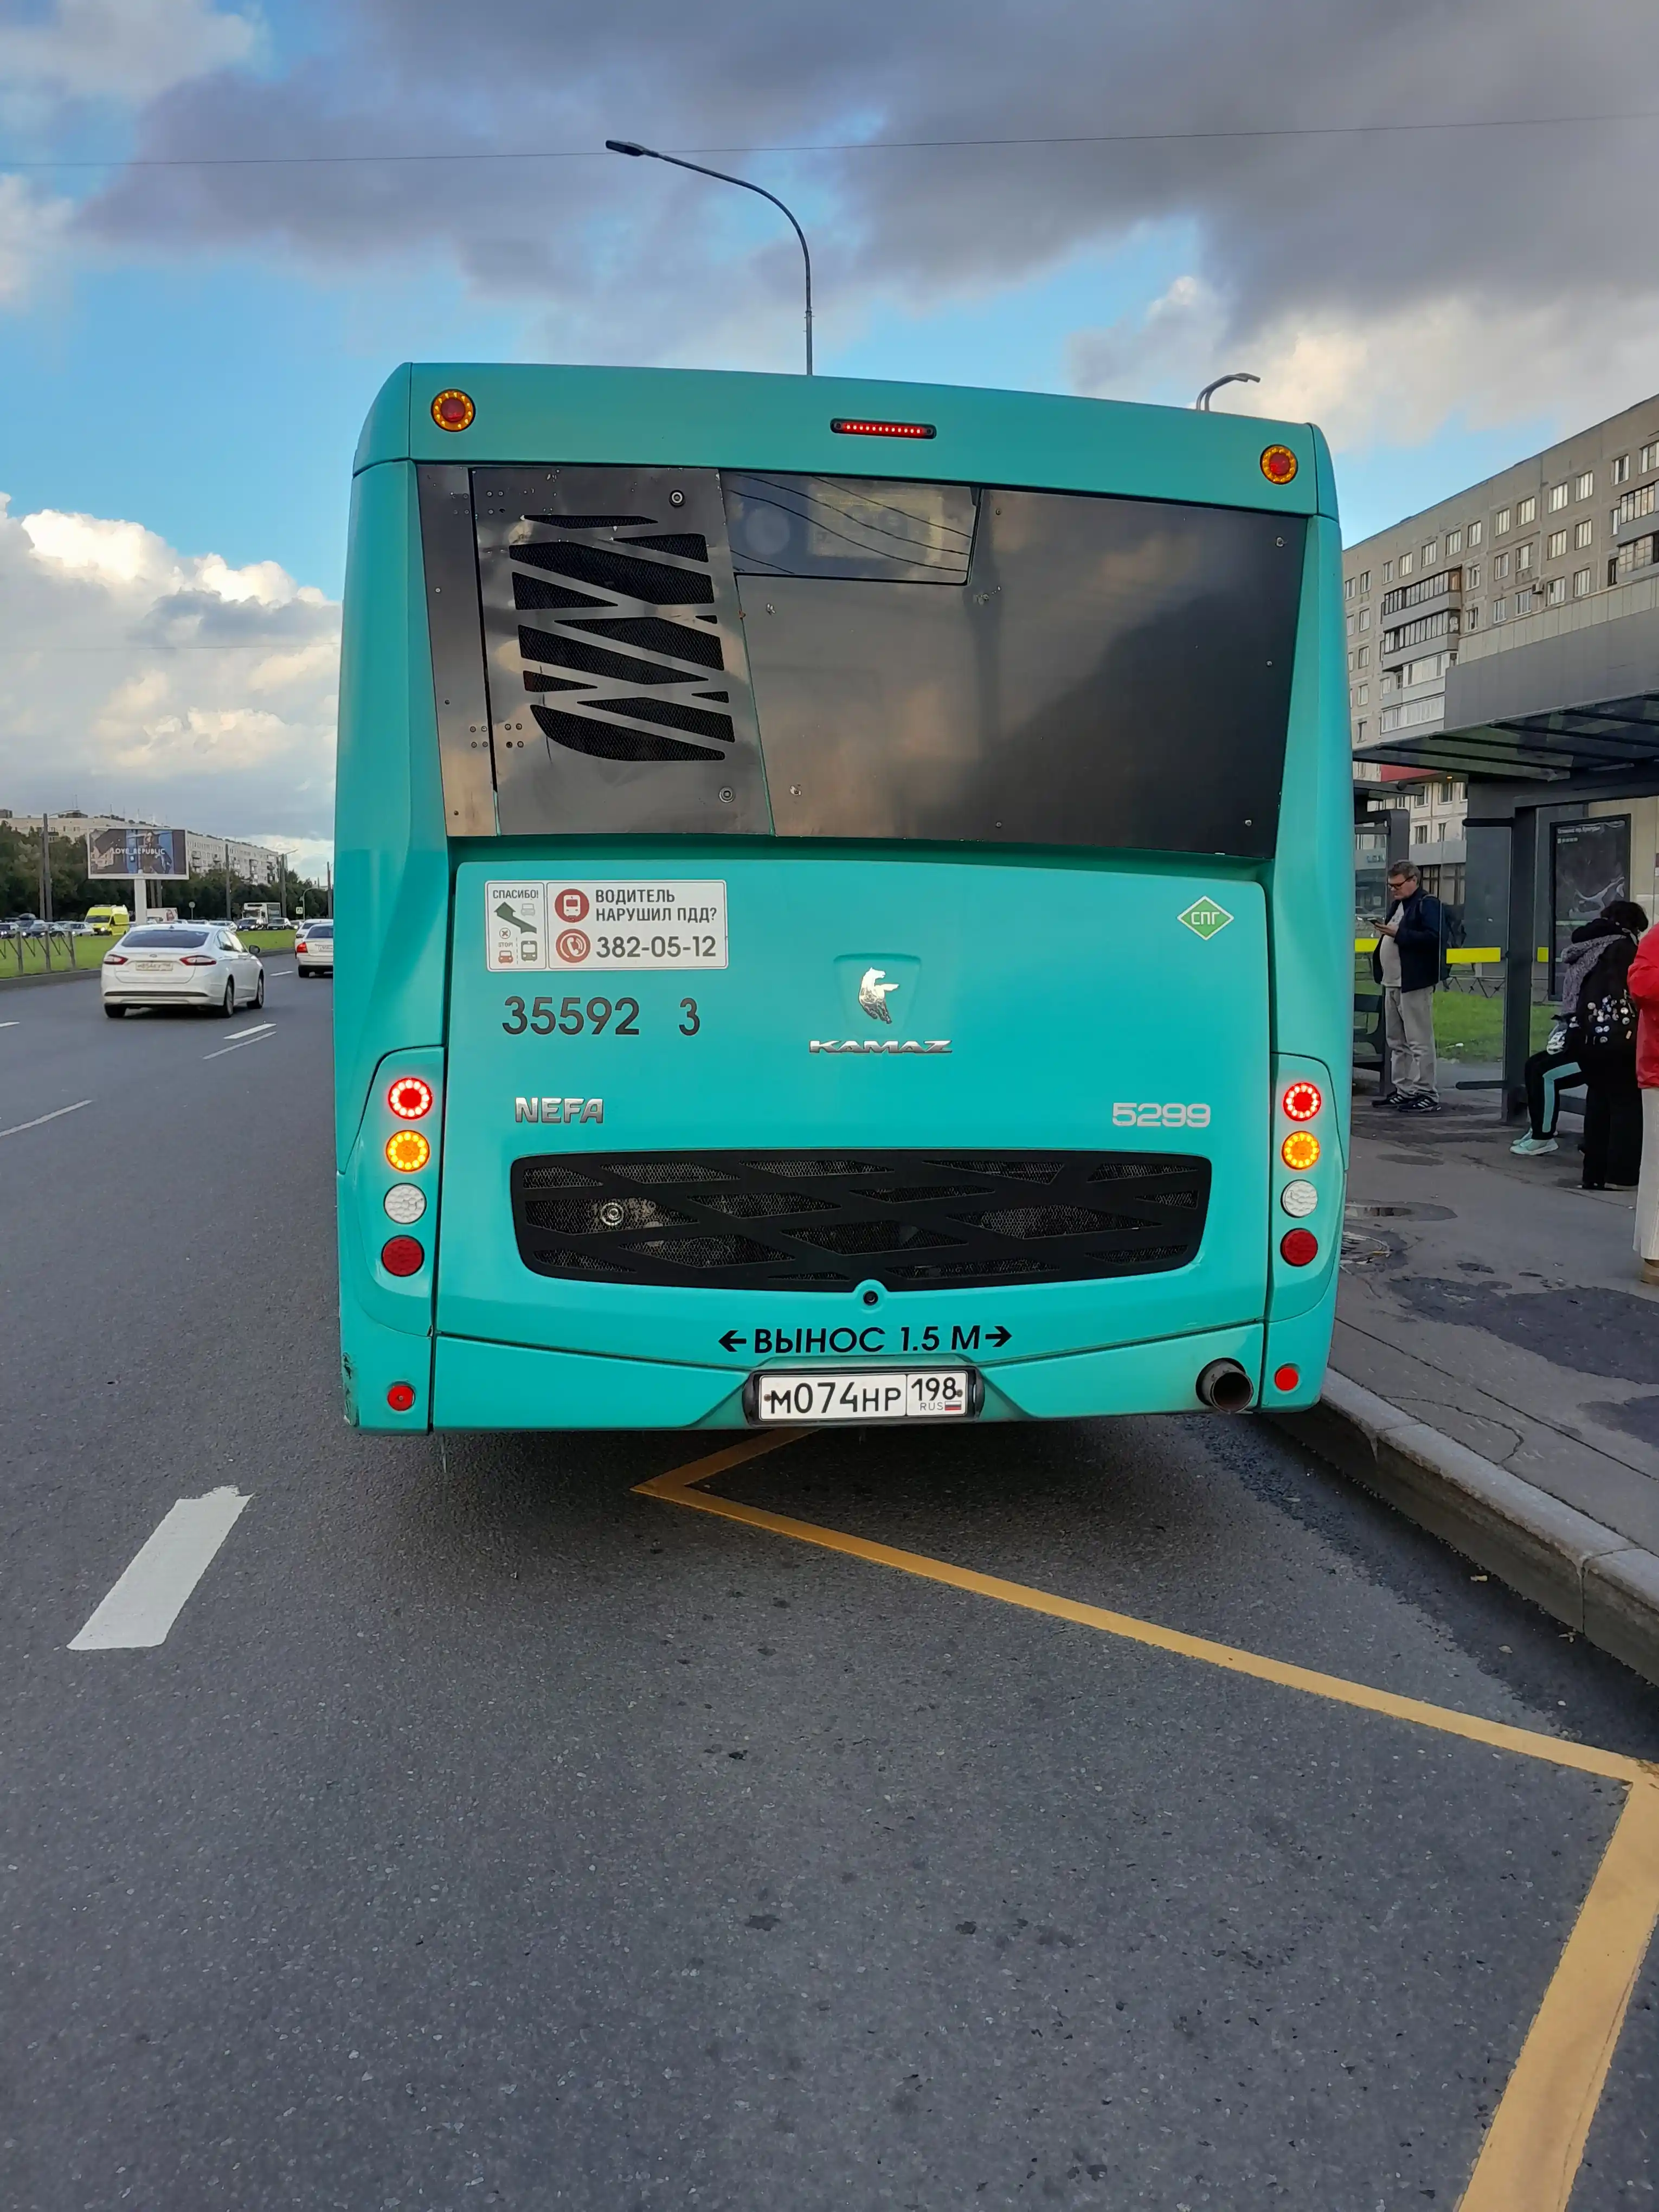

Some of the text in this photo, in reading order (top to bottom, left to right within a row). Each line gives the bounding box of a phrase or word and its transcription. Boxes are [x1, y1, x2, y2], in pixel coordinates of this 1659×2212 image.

[493, 890, 539, 898] СПАСИБО!
[596, 889, 675, 905] ВОДИТЕЛЬ
[596, 907, 717, 923] НАРУШИЛ ПДД?
[1191, 911, 1220, 925] СПГ
[596, 936, 716, 958] 382-05-12
[502, 995, 700, 1036] 35592 3
[809, 1040, 953, 1053] KAMAZ
[515, 1097, 603, 1123] NEFA
[1113, 1102, 1211, 1128] 5299
[754, 1326, 885, 1354] ВЫНОС
[900, 1326, 940, 1351] 1.5
[911, 1377, 957, 1402] 198
[920, 1402, 943, 1411] RUS
